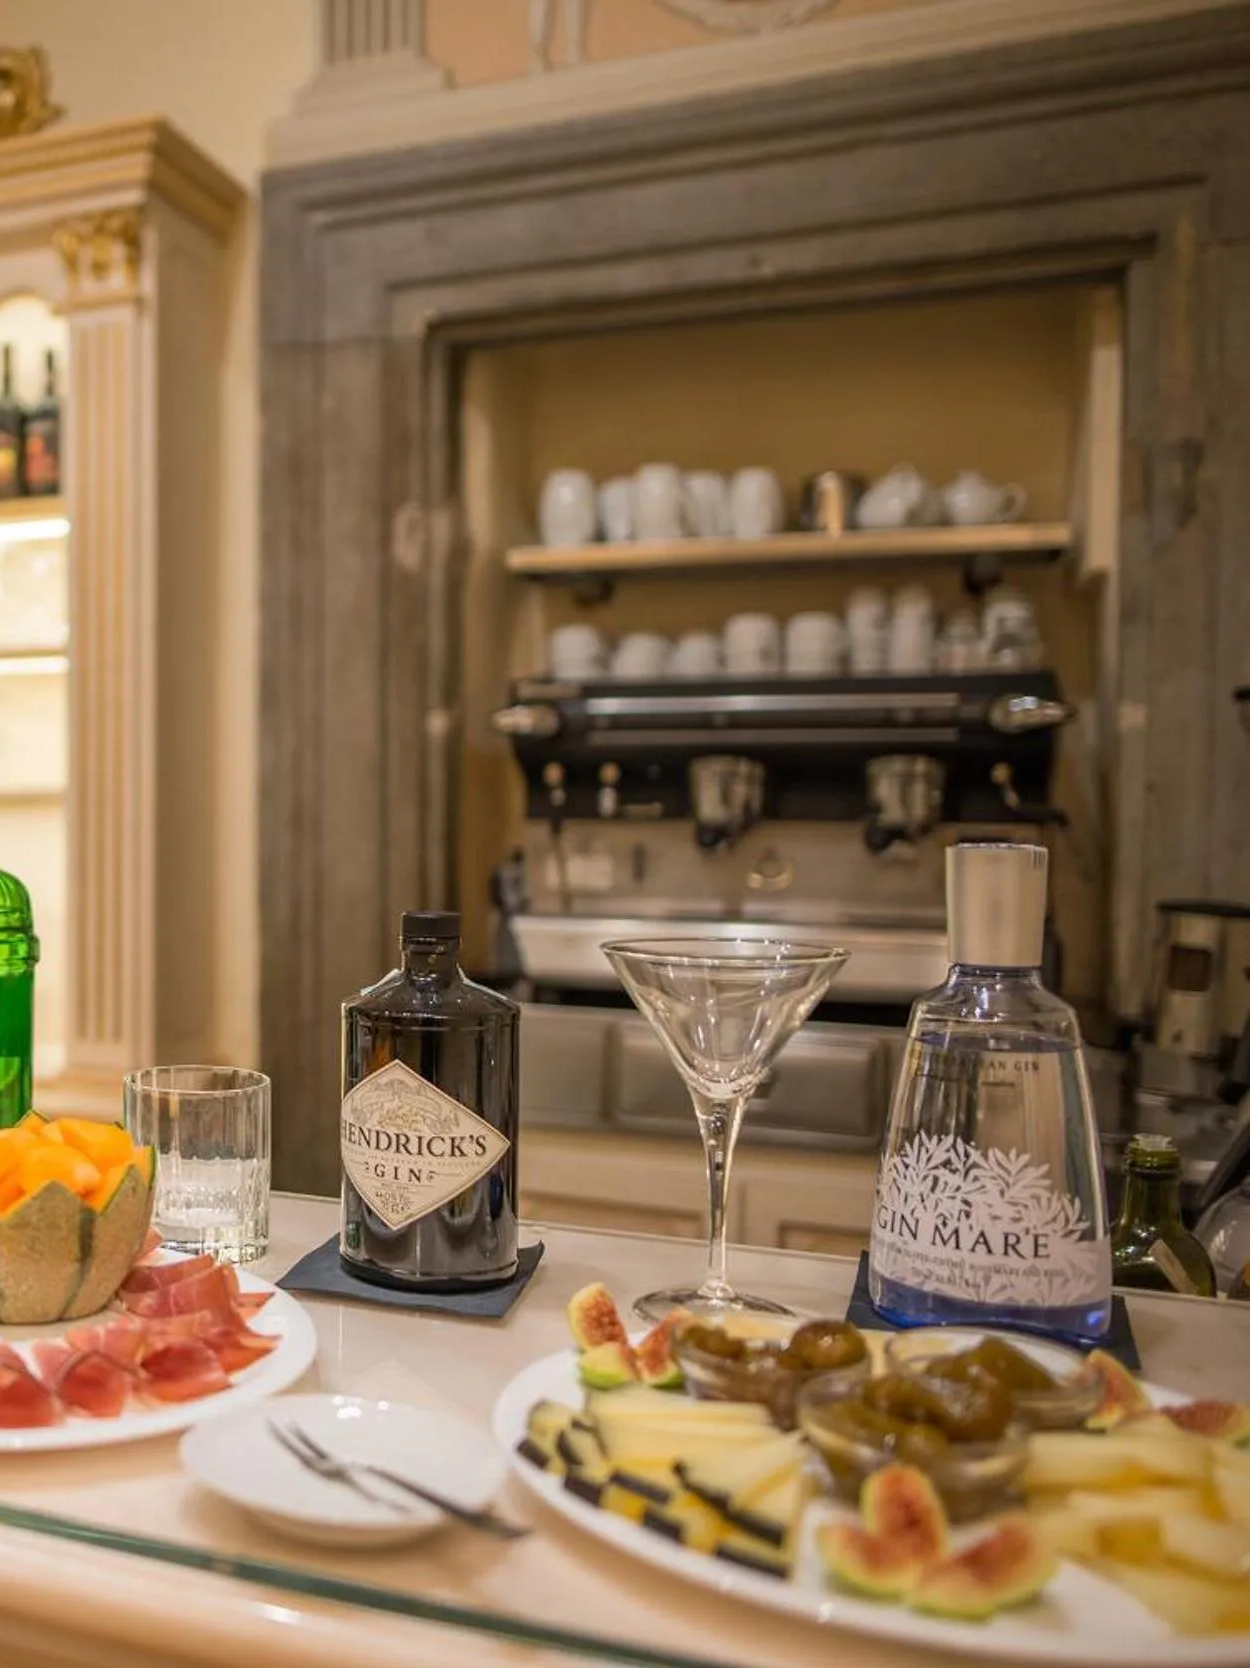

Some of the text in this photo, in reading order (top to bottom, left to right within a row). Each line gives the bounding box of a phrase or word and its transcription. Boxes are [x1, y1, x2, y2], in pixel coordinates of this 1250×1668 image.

[374, 1162, 423, 1183] GIN
[876, 1204, 920, 1240] GIN
[931, 1223, 1052, 1260] MARE
